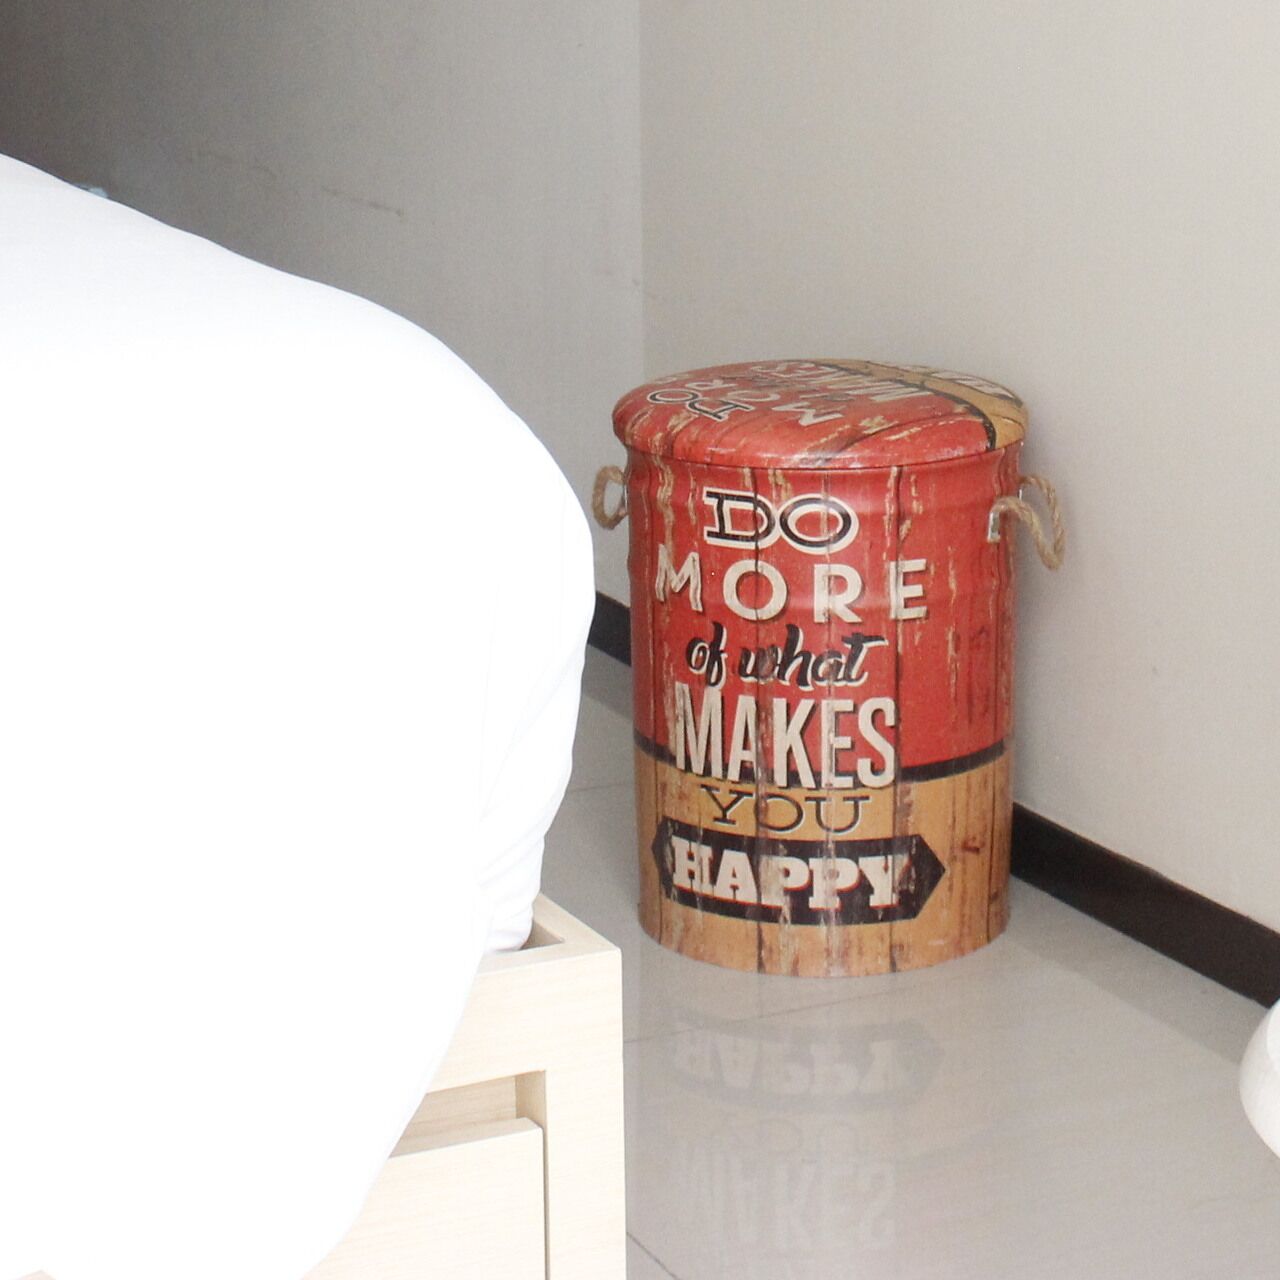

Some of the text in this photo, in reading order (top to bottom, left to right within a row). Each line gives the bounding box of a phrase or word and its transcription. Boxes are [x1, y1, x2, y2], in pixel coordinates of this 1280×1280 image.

[703, 487, 860, 554] DO
[654, 545, 930, 624] MORE
[685, 621, 889, 691] of what
[674, 681, 900, 790] MAKES
[700, 784, 873, 835] YOU
[671, 835, 915, 911] HAPPY
